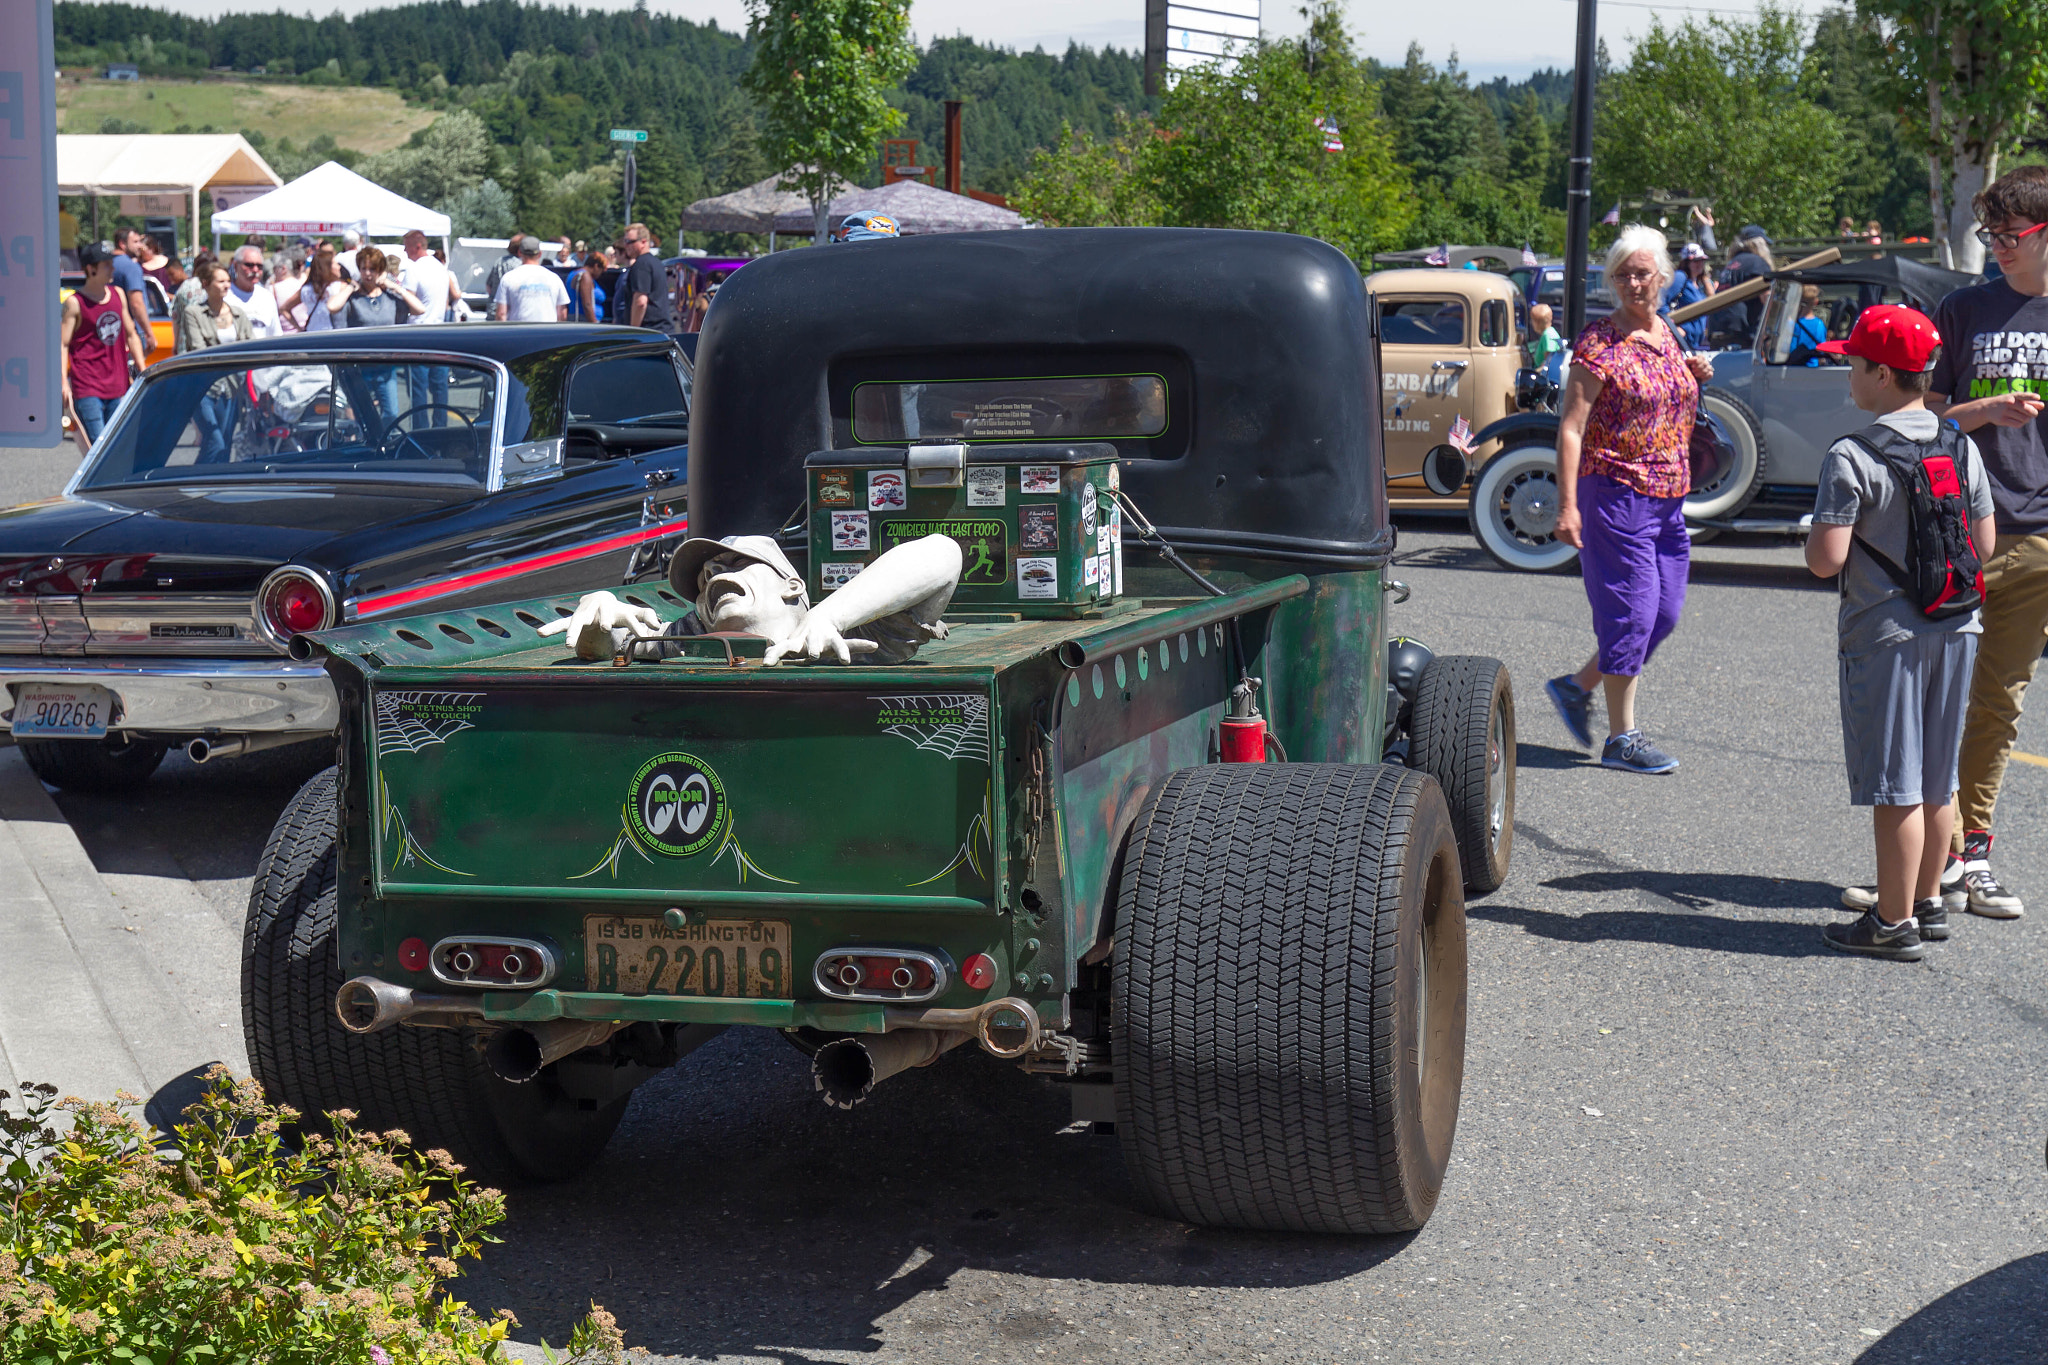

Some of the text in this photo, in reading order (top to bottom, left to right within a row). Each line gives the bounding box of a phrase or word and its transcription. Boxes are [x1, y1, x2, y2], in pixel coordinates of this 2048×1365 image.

[1972, 331, 2005, 350] SIT
[1972, 347, 2013, 365] AND
[1976, 362, 2028, 379] FROM
[1383, 373, 1458, 398] ENBAUM
[886, 522, 1000, 537] ZOMBIES HATE FAST FOOD
[153, 626, 230, 636] Fairlane 500
[35, 702, 98, 726] 90266
[631, 755, 721, 795] THEY LAUGH AT ME BECAUSE I'M DIFFERENT
[654, 790, 702, 802] MOON
[631, 807, 642, 826] LAUGH
[715, 802, 723, 820] SAME
[638, 824, 647, 834] AT
[711, 819, 720, 831] THE
[643, 831, 659, 846] THEM
[697, 836, 708, 846] ARE
[705, 828, 715, 840] ALL
[657, 841, 683, 852] BECAUSE
[683, 841, 698, 851] THEY
[598, 924, 776, 942] 1938 WASHINGTON
